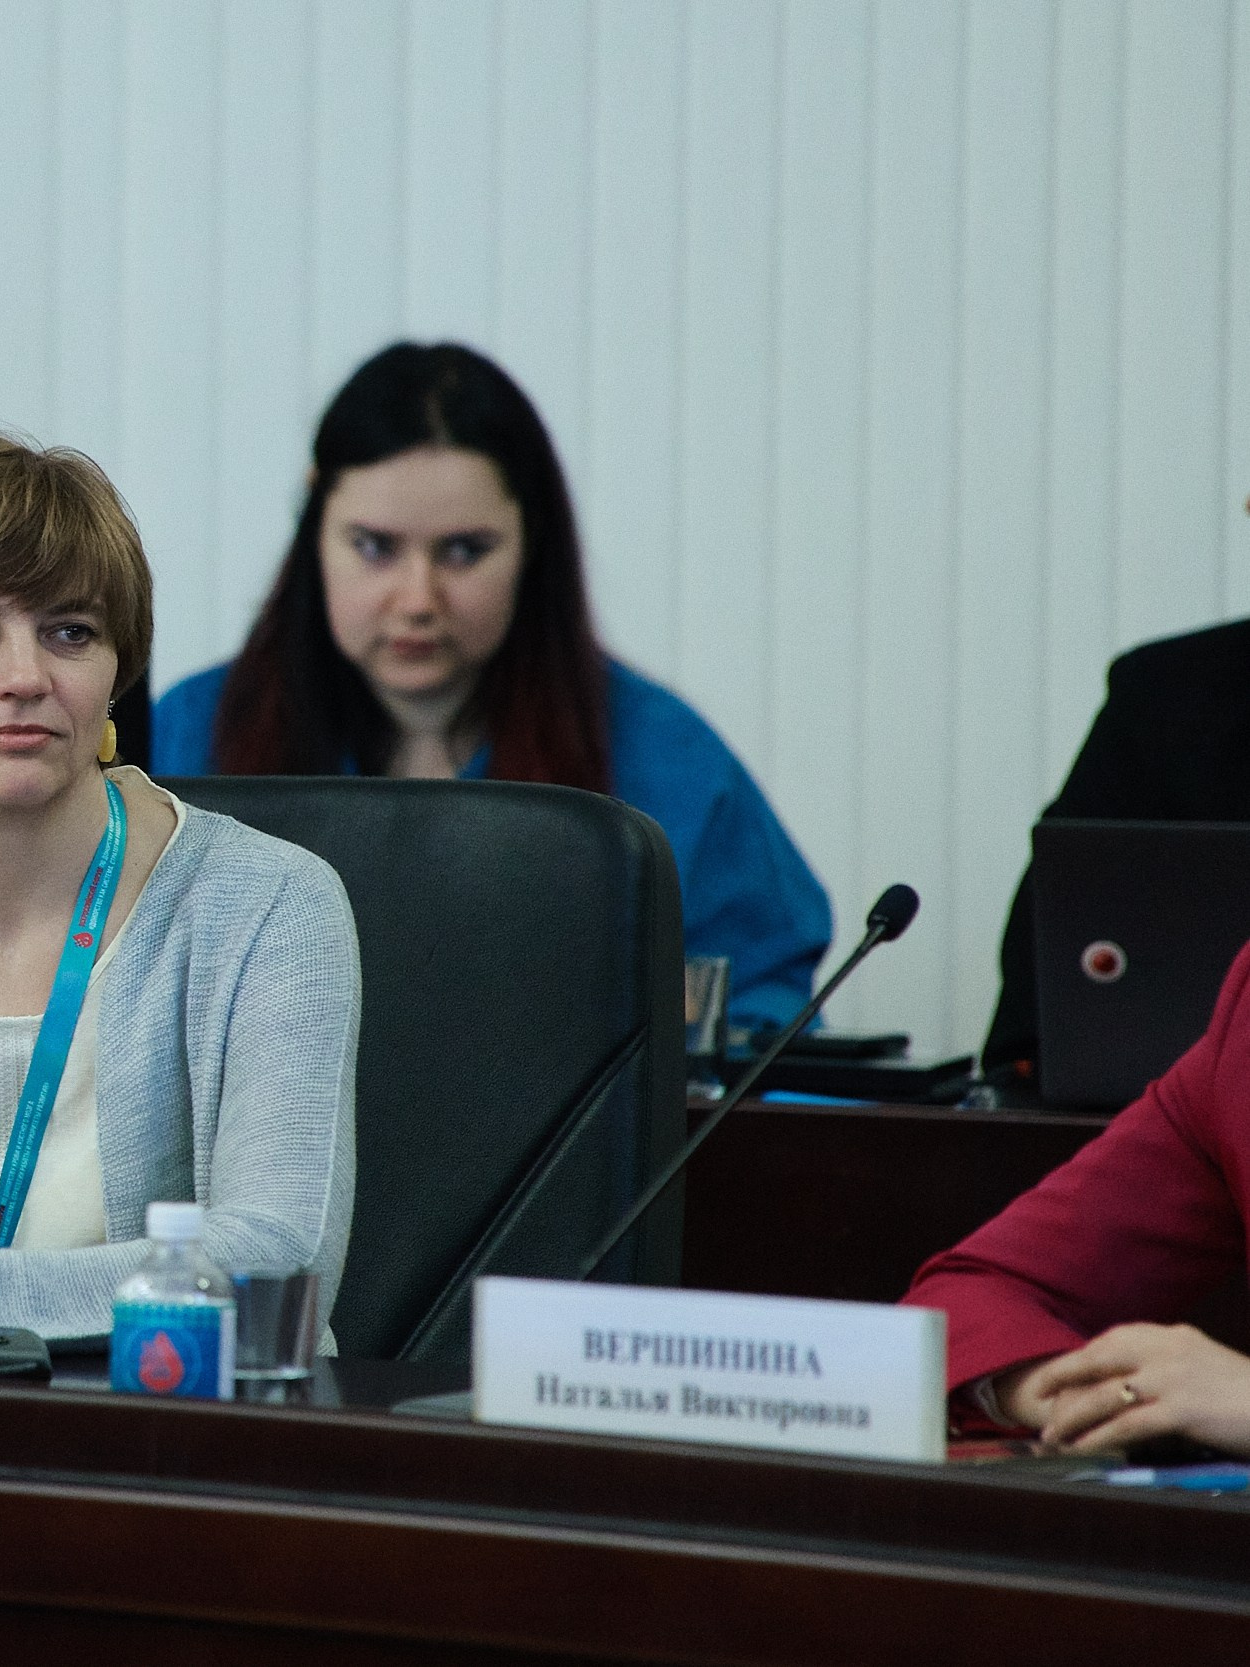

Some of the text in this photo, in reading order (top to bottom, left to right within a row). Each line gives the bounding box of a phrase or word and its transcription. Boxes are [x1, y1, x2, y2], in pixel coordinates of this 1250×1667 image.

[582, 1327, 823, 1378] ВЕРШИНИНА
[534, 1372, 872, 1432] Наталья Викторовна
